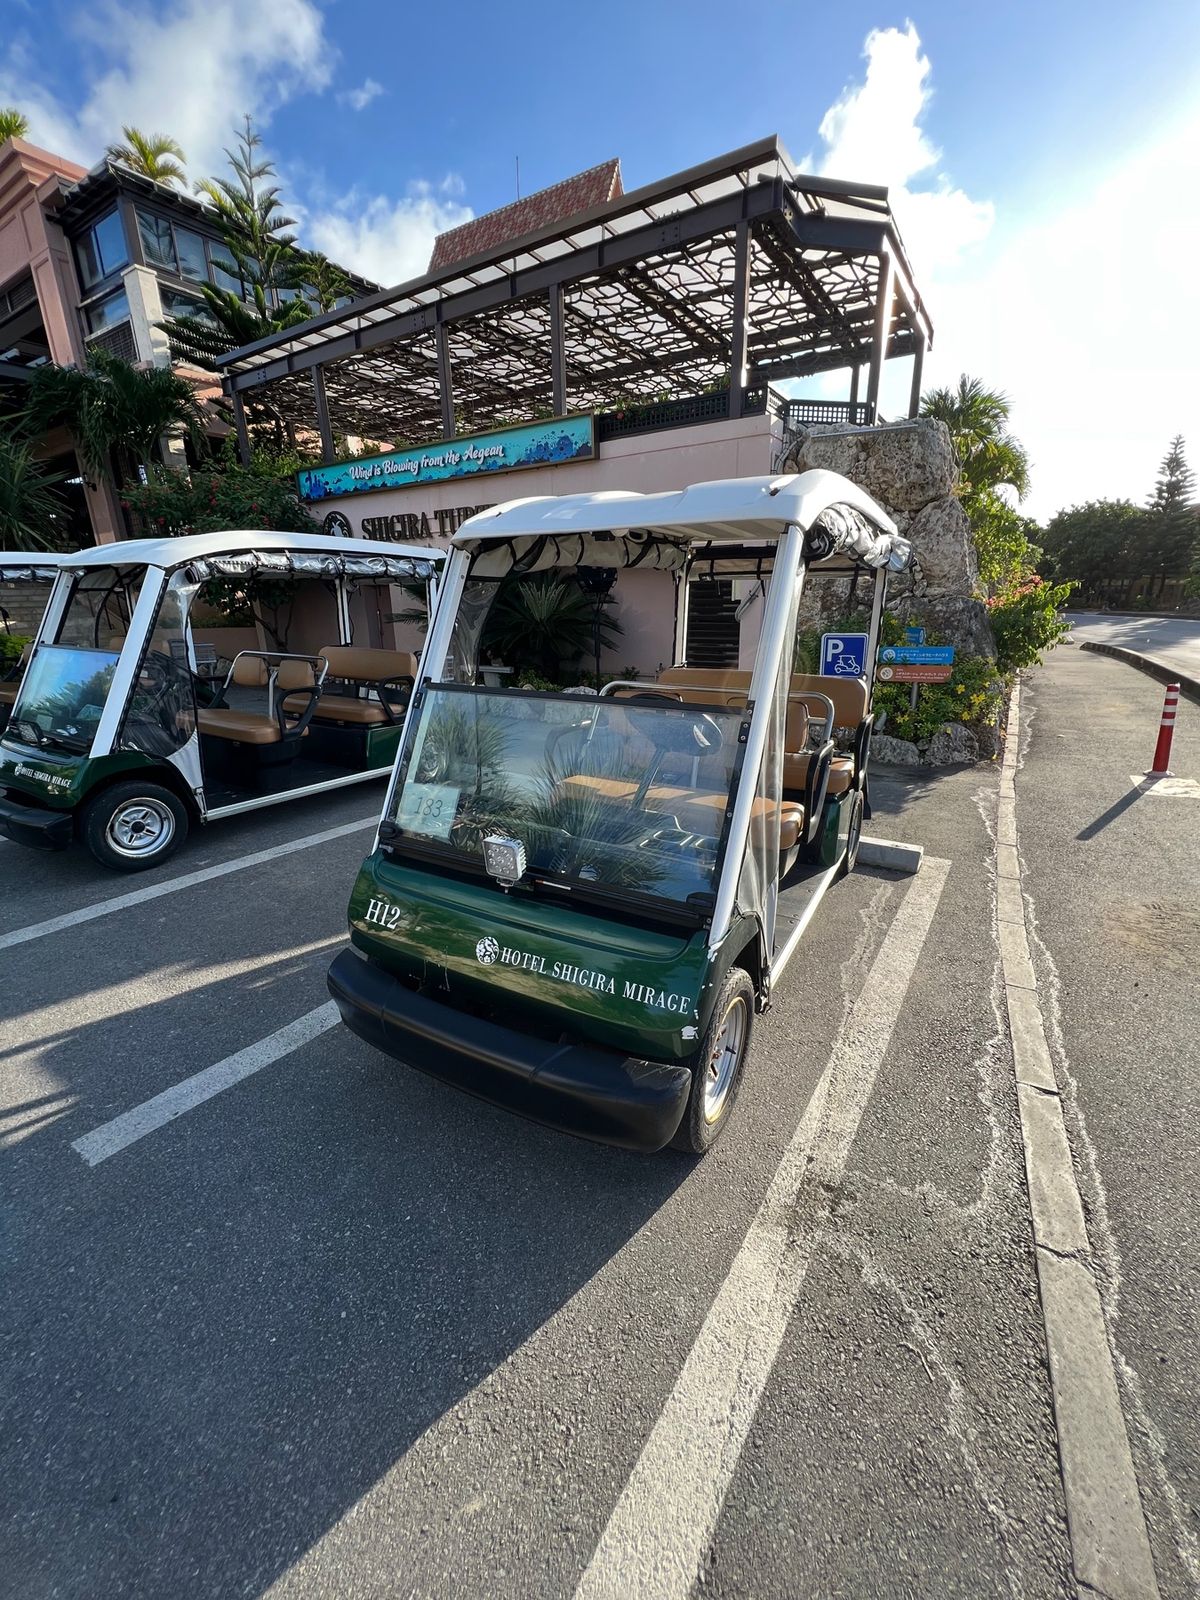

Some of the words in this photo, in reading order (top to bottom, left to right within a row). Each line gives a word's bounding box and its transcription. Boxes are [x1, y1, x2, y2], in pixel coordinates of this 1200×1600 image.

[350, 466, 373, 480] Wind
[373, 464, 381, 475] is
[382, 459, 419, 475] Blowing
[420, 455, 444, 468] from
[445, 450, 460, 465] the
[462, 443, 505, 465] Aegean
[361, 511, 433, 542] SHIGIRA
[826, 639, 844, 662] P
[414, 796, 444, 819] 183
[364, 899, 401, 931] H12
[500, 946, 547, 975] HOTEL
[552, 961, 616, 995] SHIGIRA
[622, 980, 691, 1015] MIRAGE
